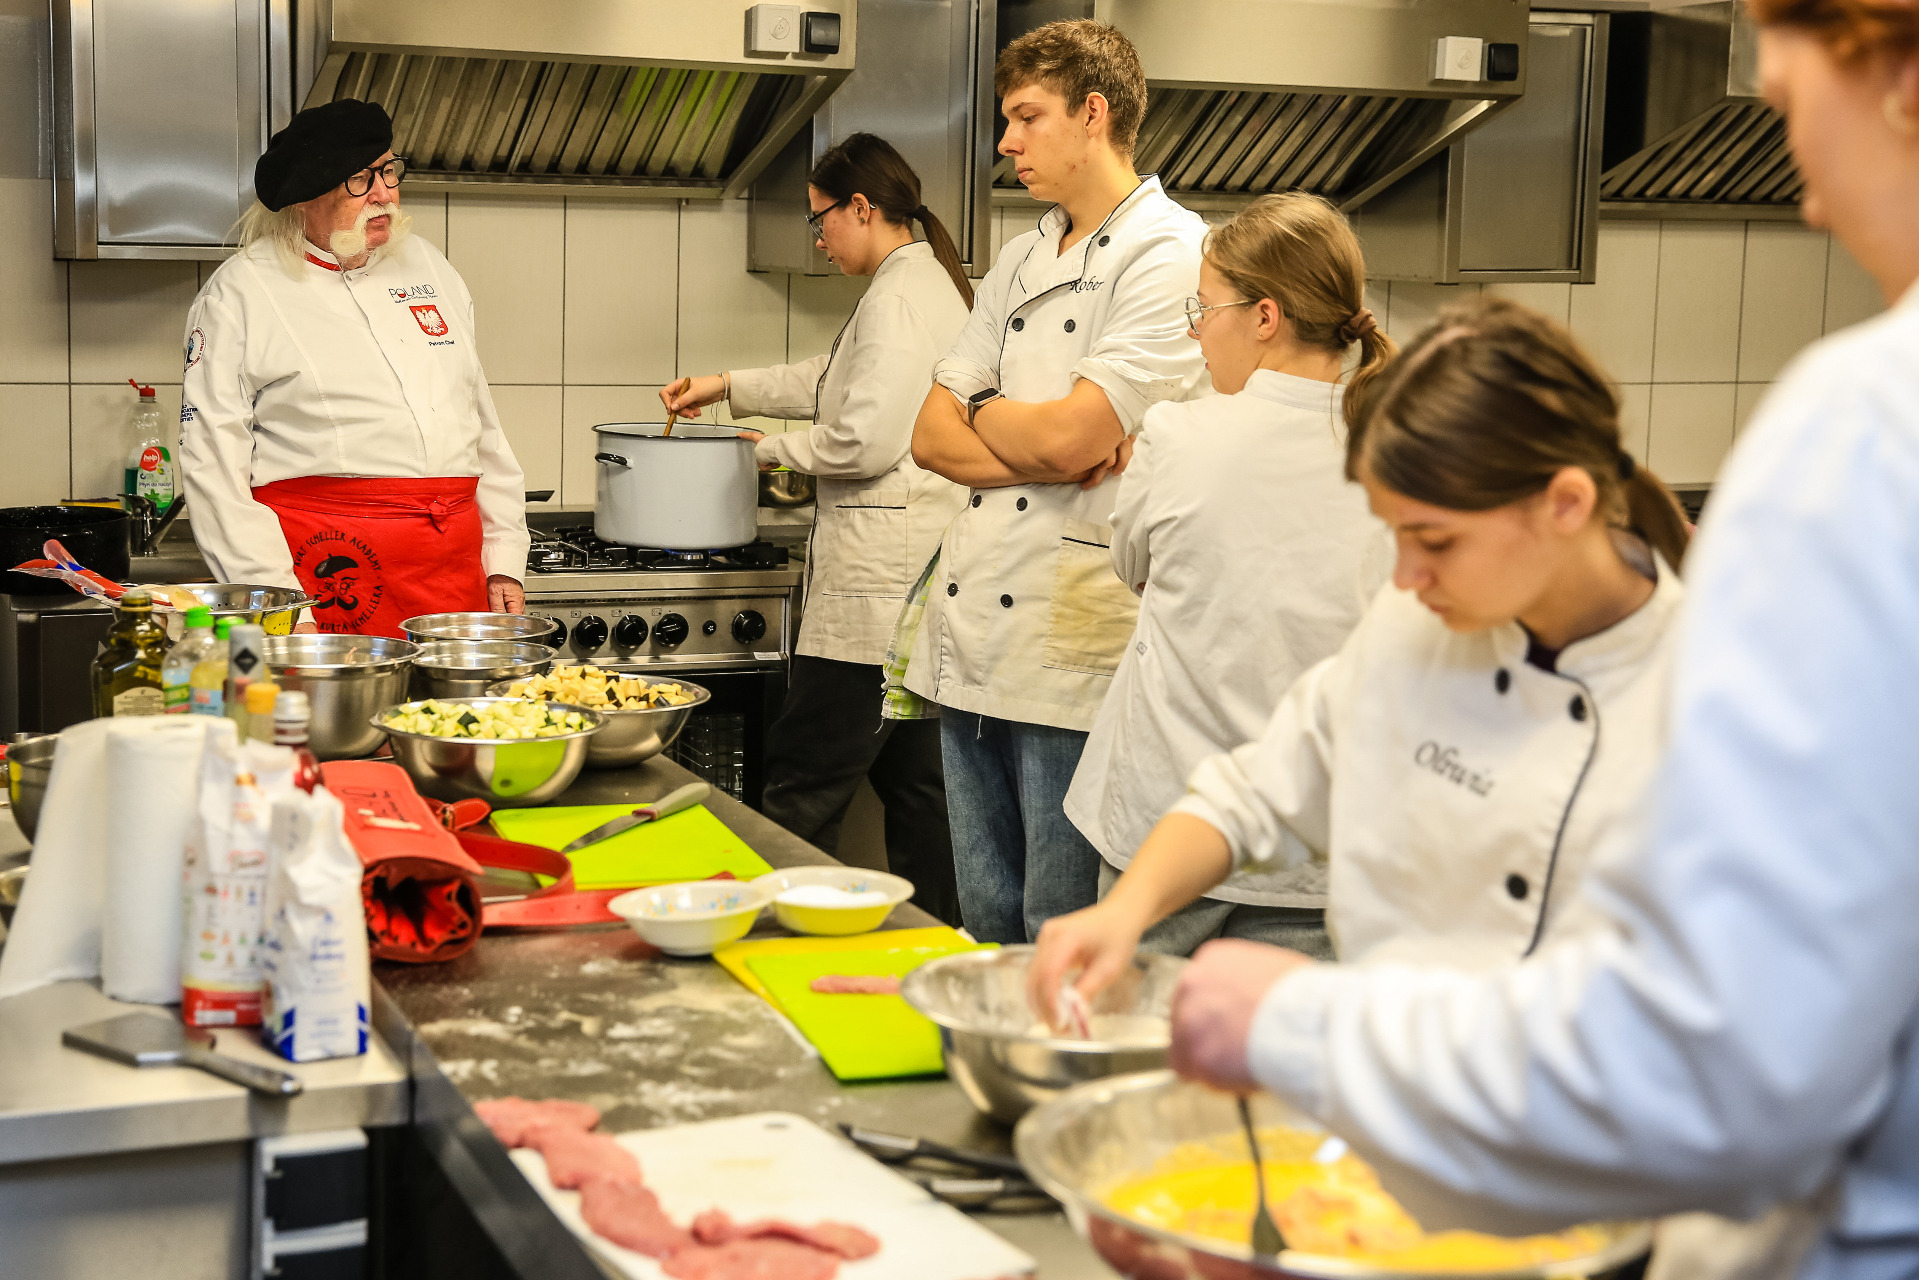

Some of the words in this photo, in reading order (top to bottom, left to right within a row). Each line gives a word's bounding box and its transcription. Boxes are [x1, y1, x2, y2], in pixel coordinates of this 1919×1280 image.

[388, 284, 434, 298] POLAND
[1069, 276, 1104, 293] Rober
[294, 545, 307, 567] KURT
[305, 530, 346, 547] SCHELLER
[349, 536, 382, 571] ACADEMY
[320, 622, 349, 633] KURTA
[351, 585, 384, 630] SCHELLERA
